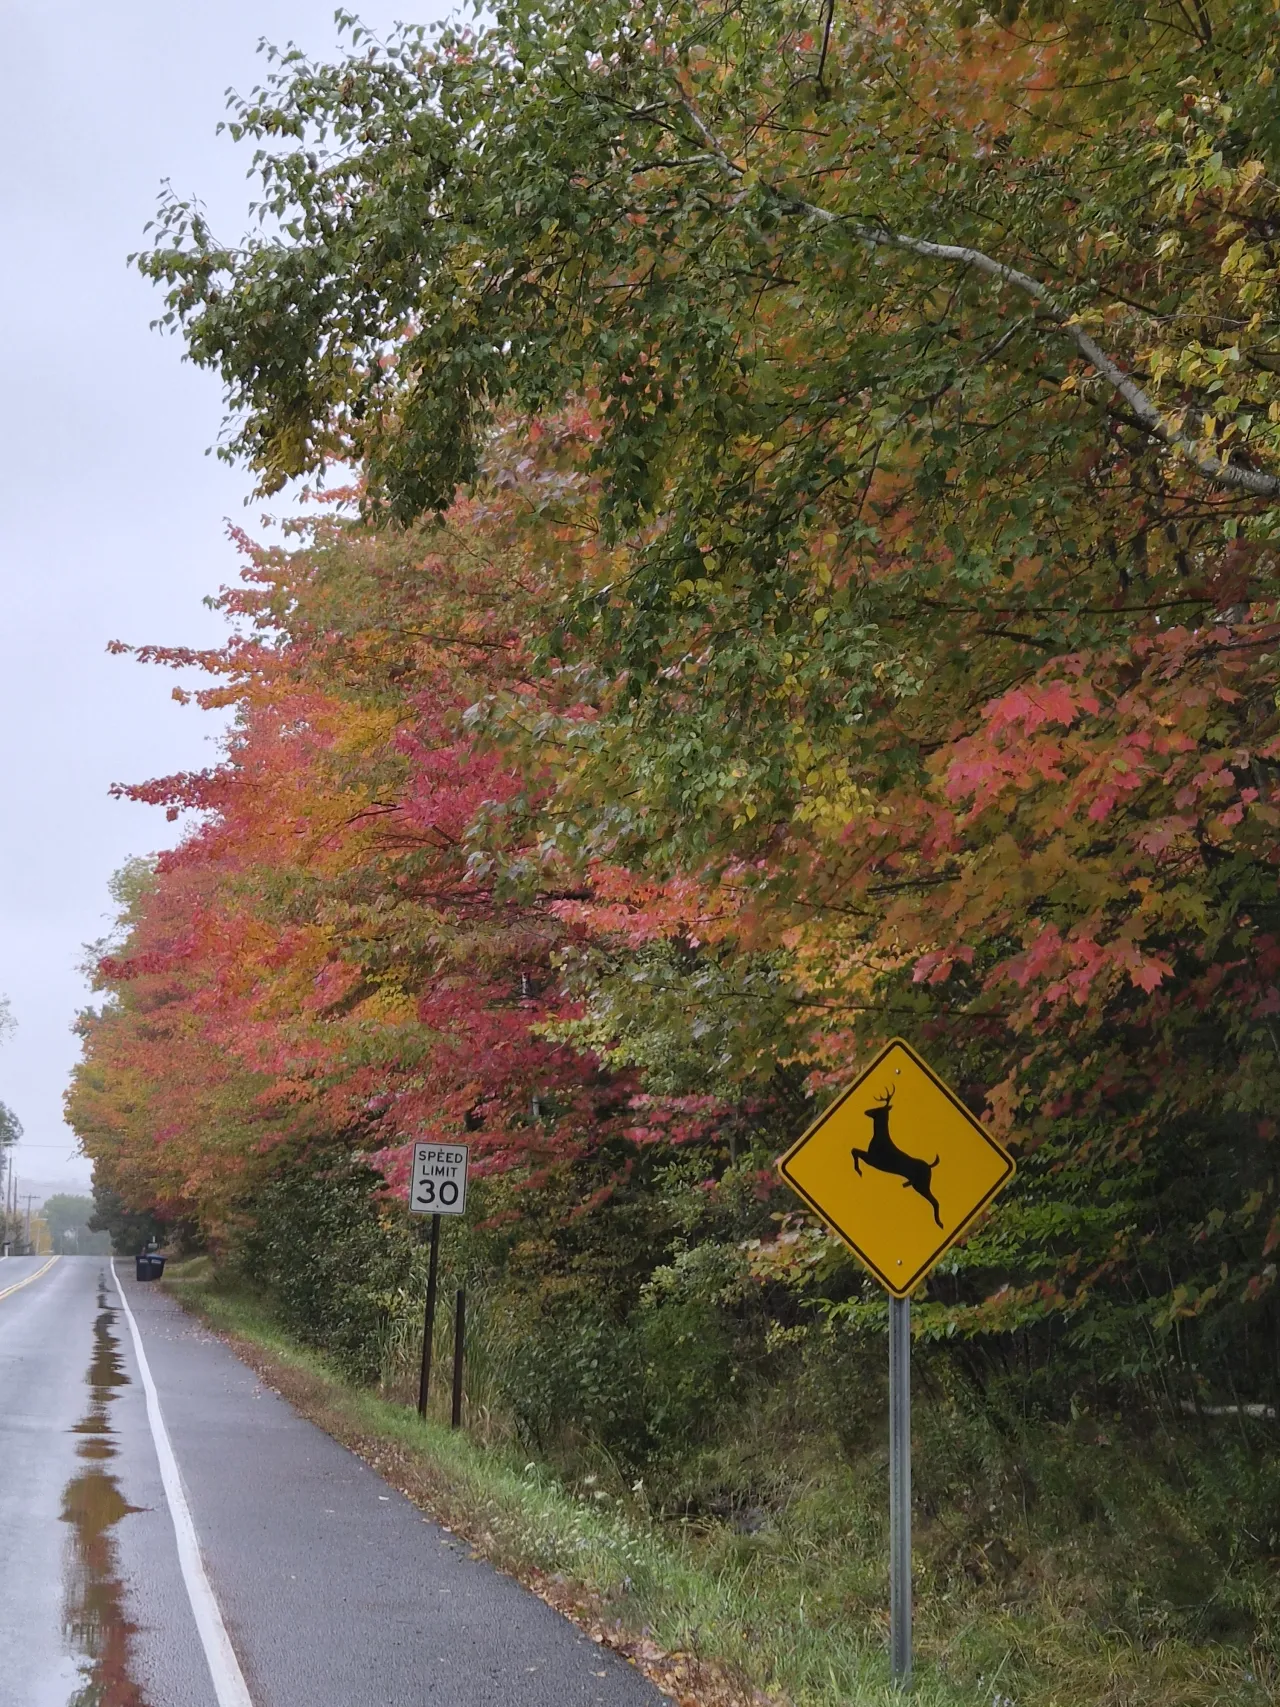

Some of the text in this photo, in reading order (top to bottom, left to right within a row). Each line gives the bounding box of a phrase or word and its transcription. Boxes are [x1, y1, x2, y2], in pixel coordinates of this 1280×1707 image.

[418, 1150, 463, 1163] SPEED
[422, 1165, 458, 1177] LIMIT
[417, 1179, 459, 1205] 30
